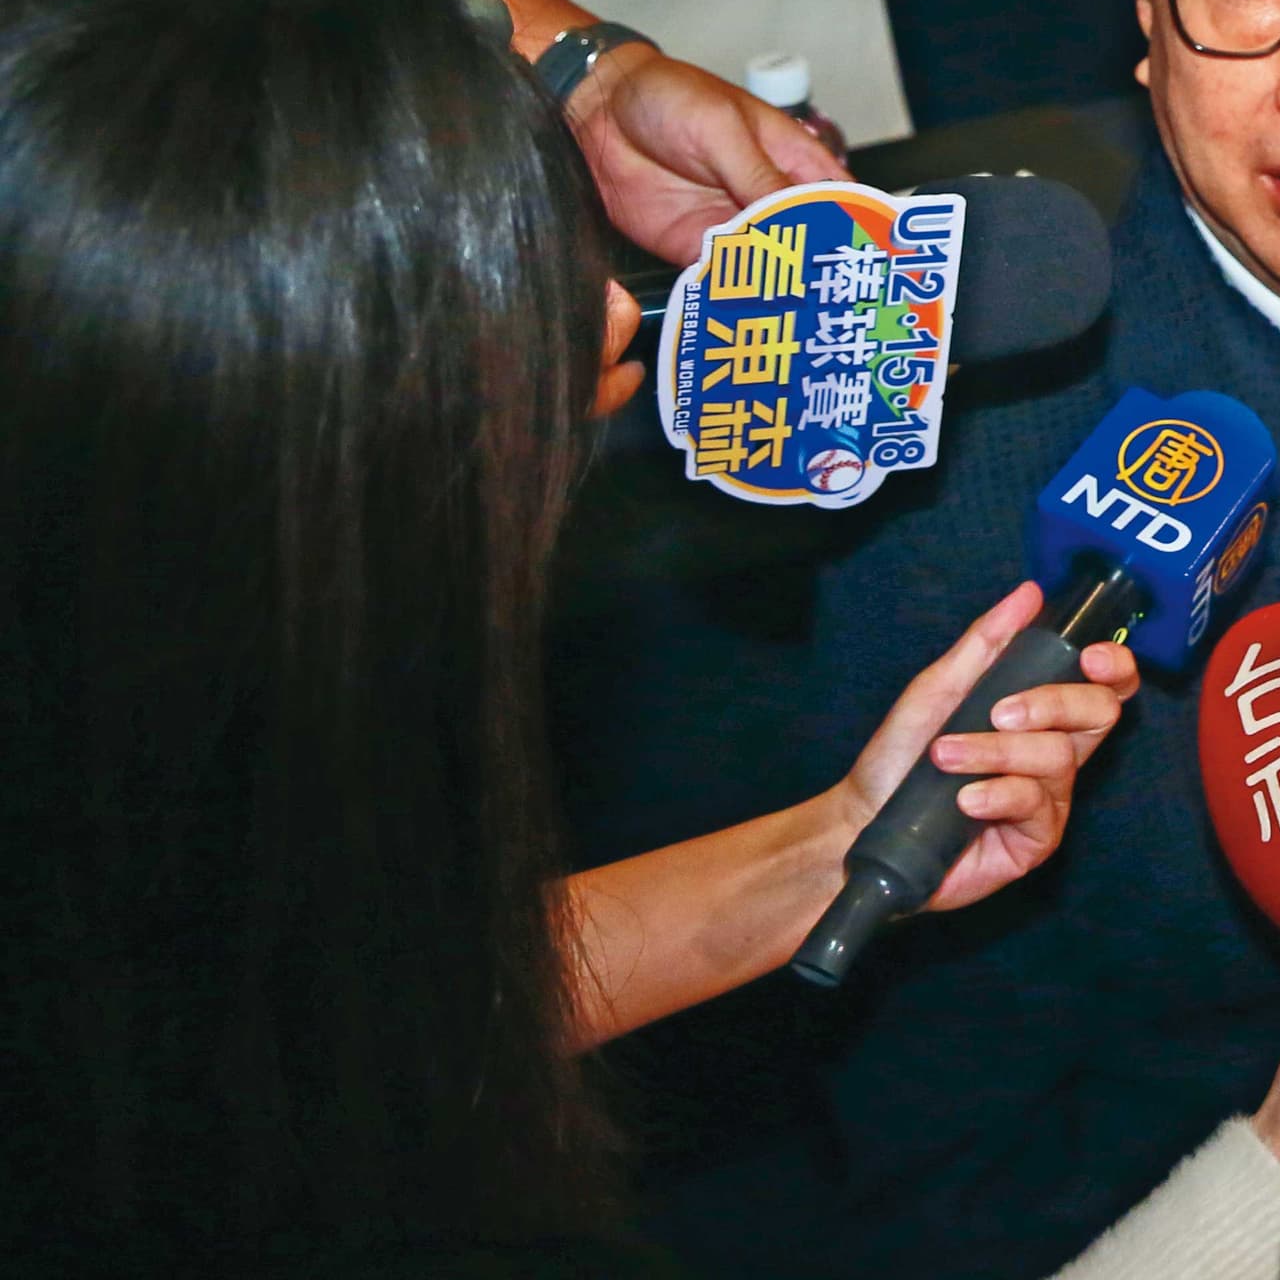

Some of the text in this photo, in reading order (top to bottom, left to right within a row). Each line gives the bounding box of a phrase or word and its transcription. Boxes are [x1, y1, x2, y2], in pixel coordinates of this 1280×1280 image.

[681, 282, 702, 356] BASEBALL
[695, 222, 808, 476] 看東森
[797, 243, 888, 431] 棒球賽
[676, 358, 695, 404] WORLD
[1116, 428, 1215, 507] 唐
[1060, 473, 1193, 553] NTD
